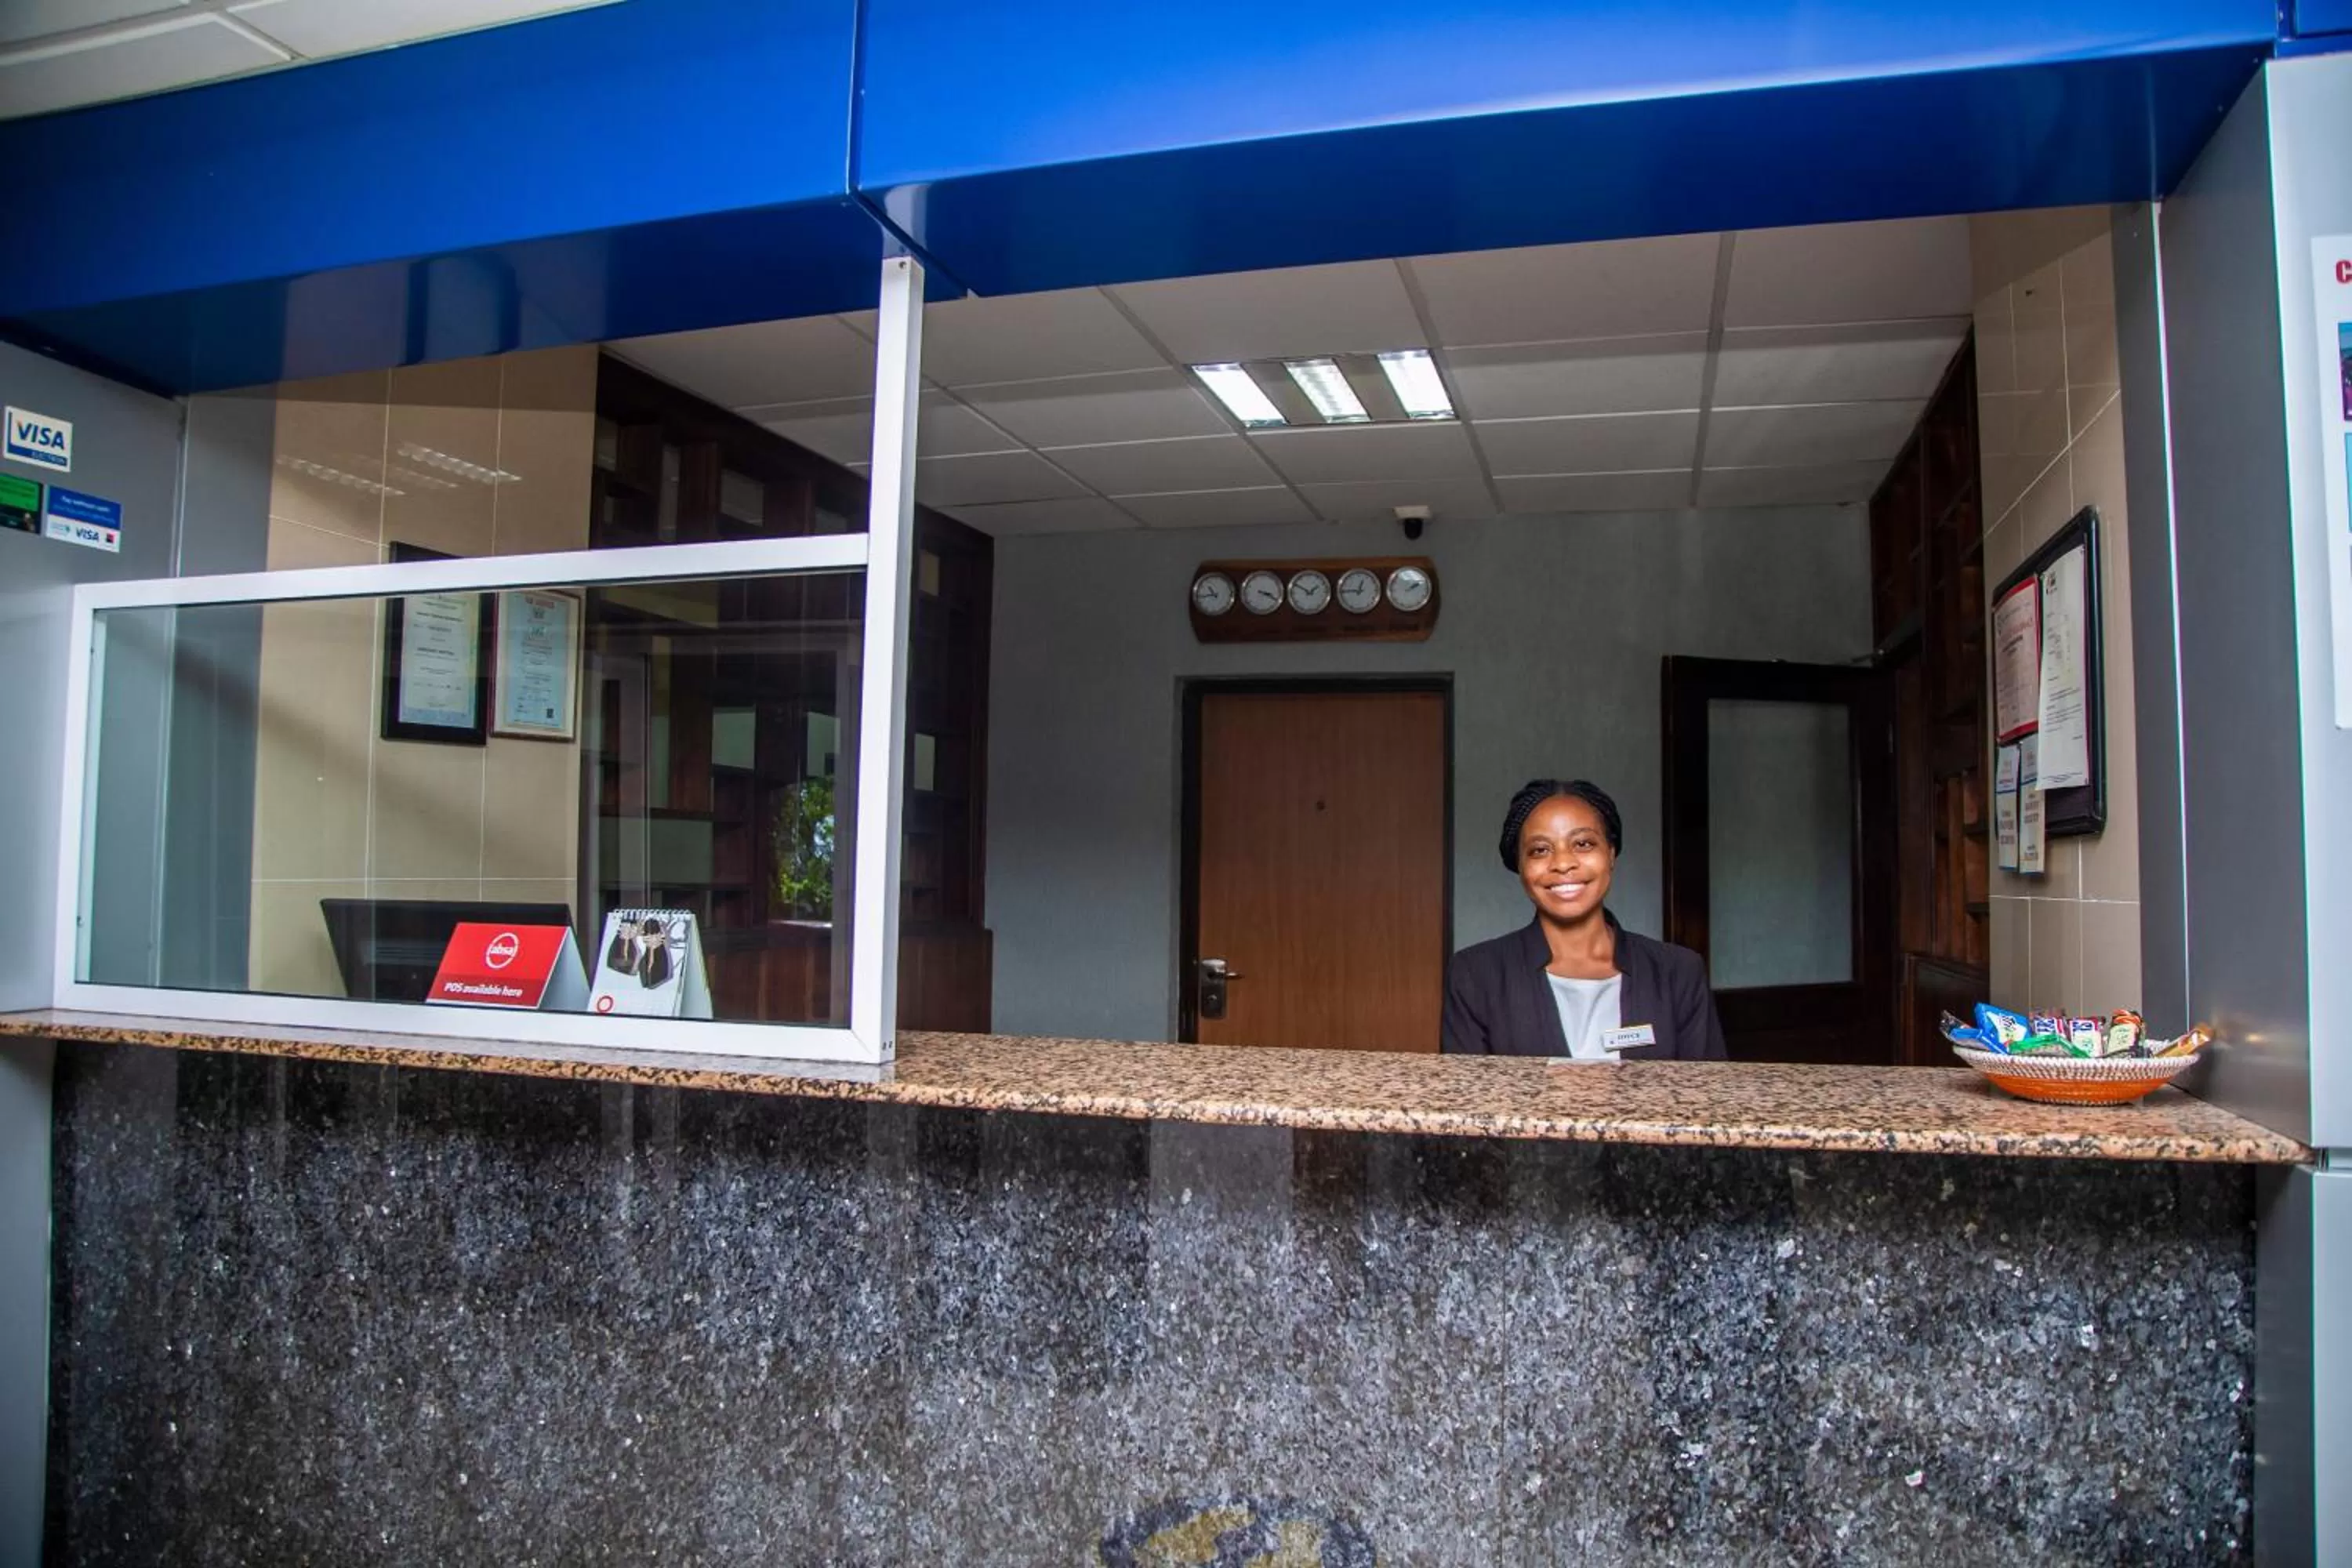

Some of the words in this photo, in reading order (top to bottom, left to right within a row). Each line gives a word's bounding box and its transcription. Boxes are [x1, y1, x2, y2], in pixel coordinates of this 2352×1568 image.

[16, 420, 64, 450] VISA
[75, 527, 100, 543] VISA
[444, 982, 463, 993] POS
[463, 984, 502, 996] available
[502, 985, 523, 997] here
